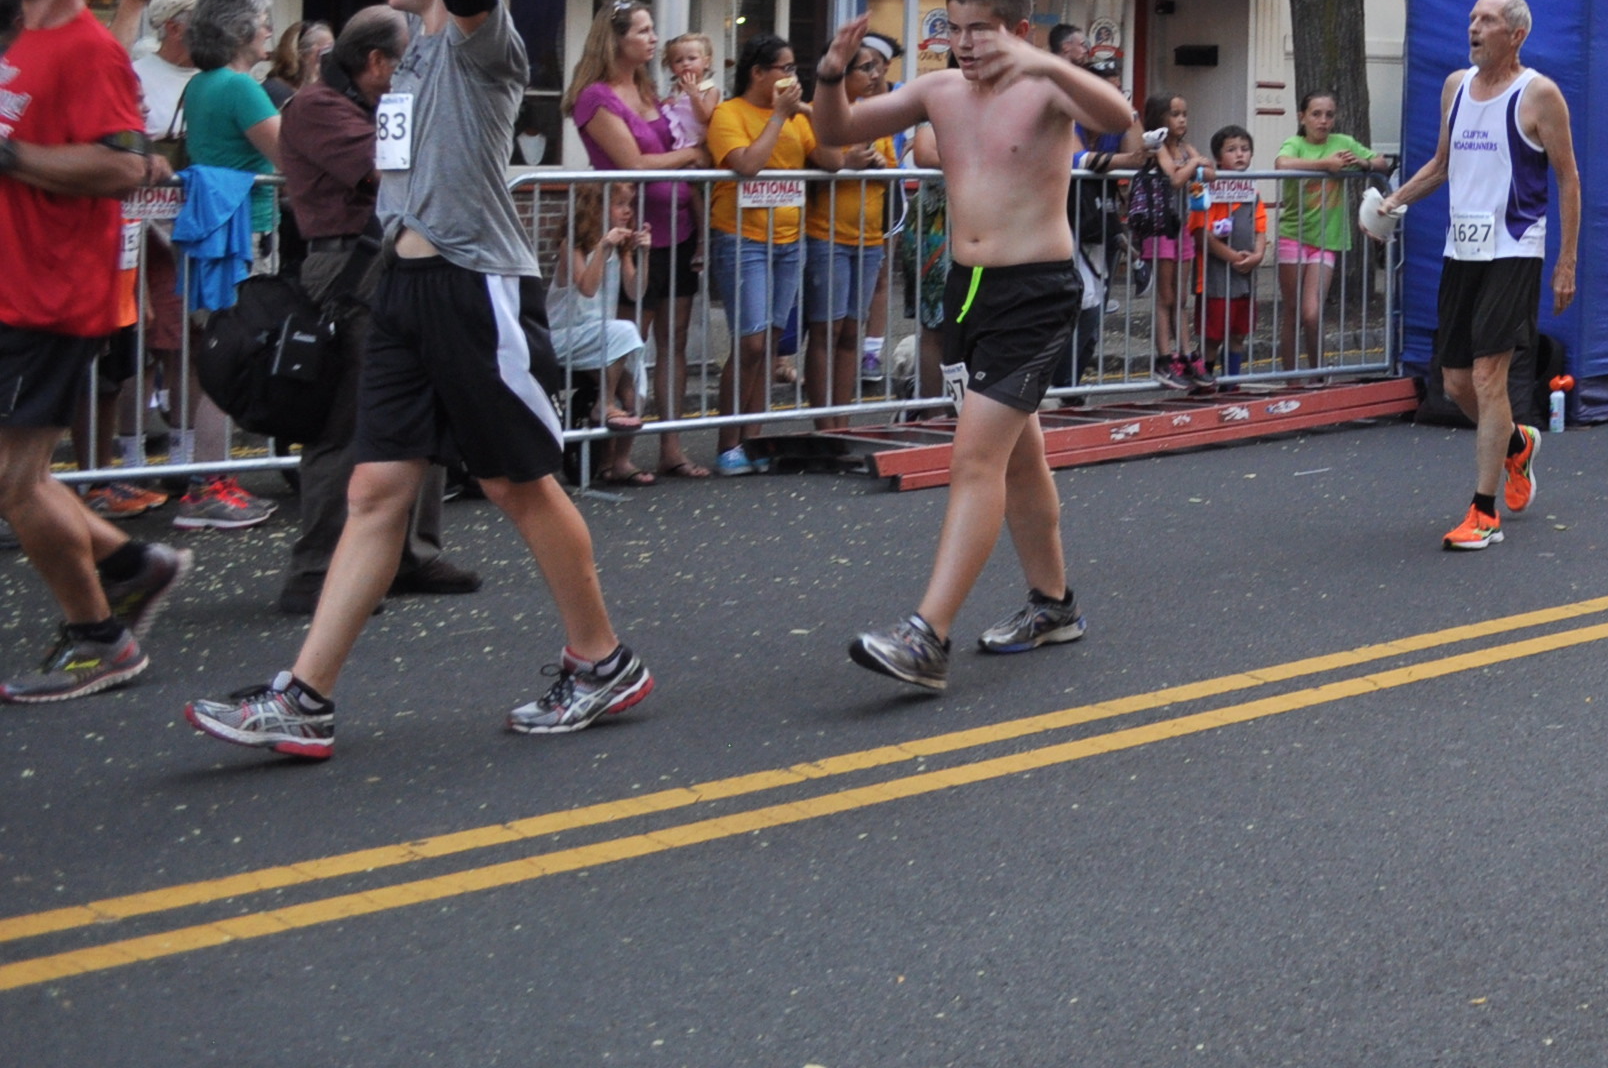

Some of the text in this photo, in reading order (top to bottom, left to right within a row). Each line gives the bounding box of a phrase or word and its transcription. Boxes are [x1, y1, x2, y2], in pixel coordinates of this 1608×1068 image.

[1462, 129, 1489, 140] CLIFTON
[1453, 142, 1498, 151] ROADRUNNERS
[743, 180, 803, 194] NATIONAL
[1208, 180, 1254, 192] NATIONAL
[121, 187, 187, 204] TIONAL
[1453, 223, 1492, 243] 1627
